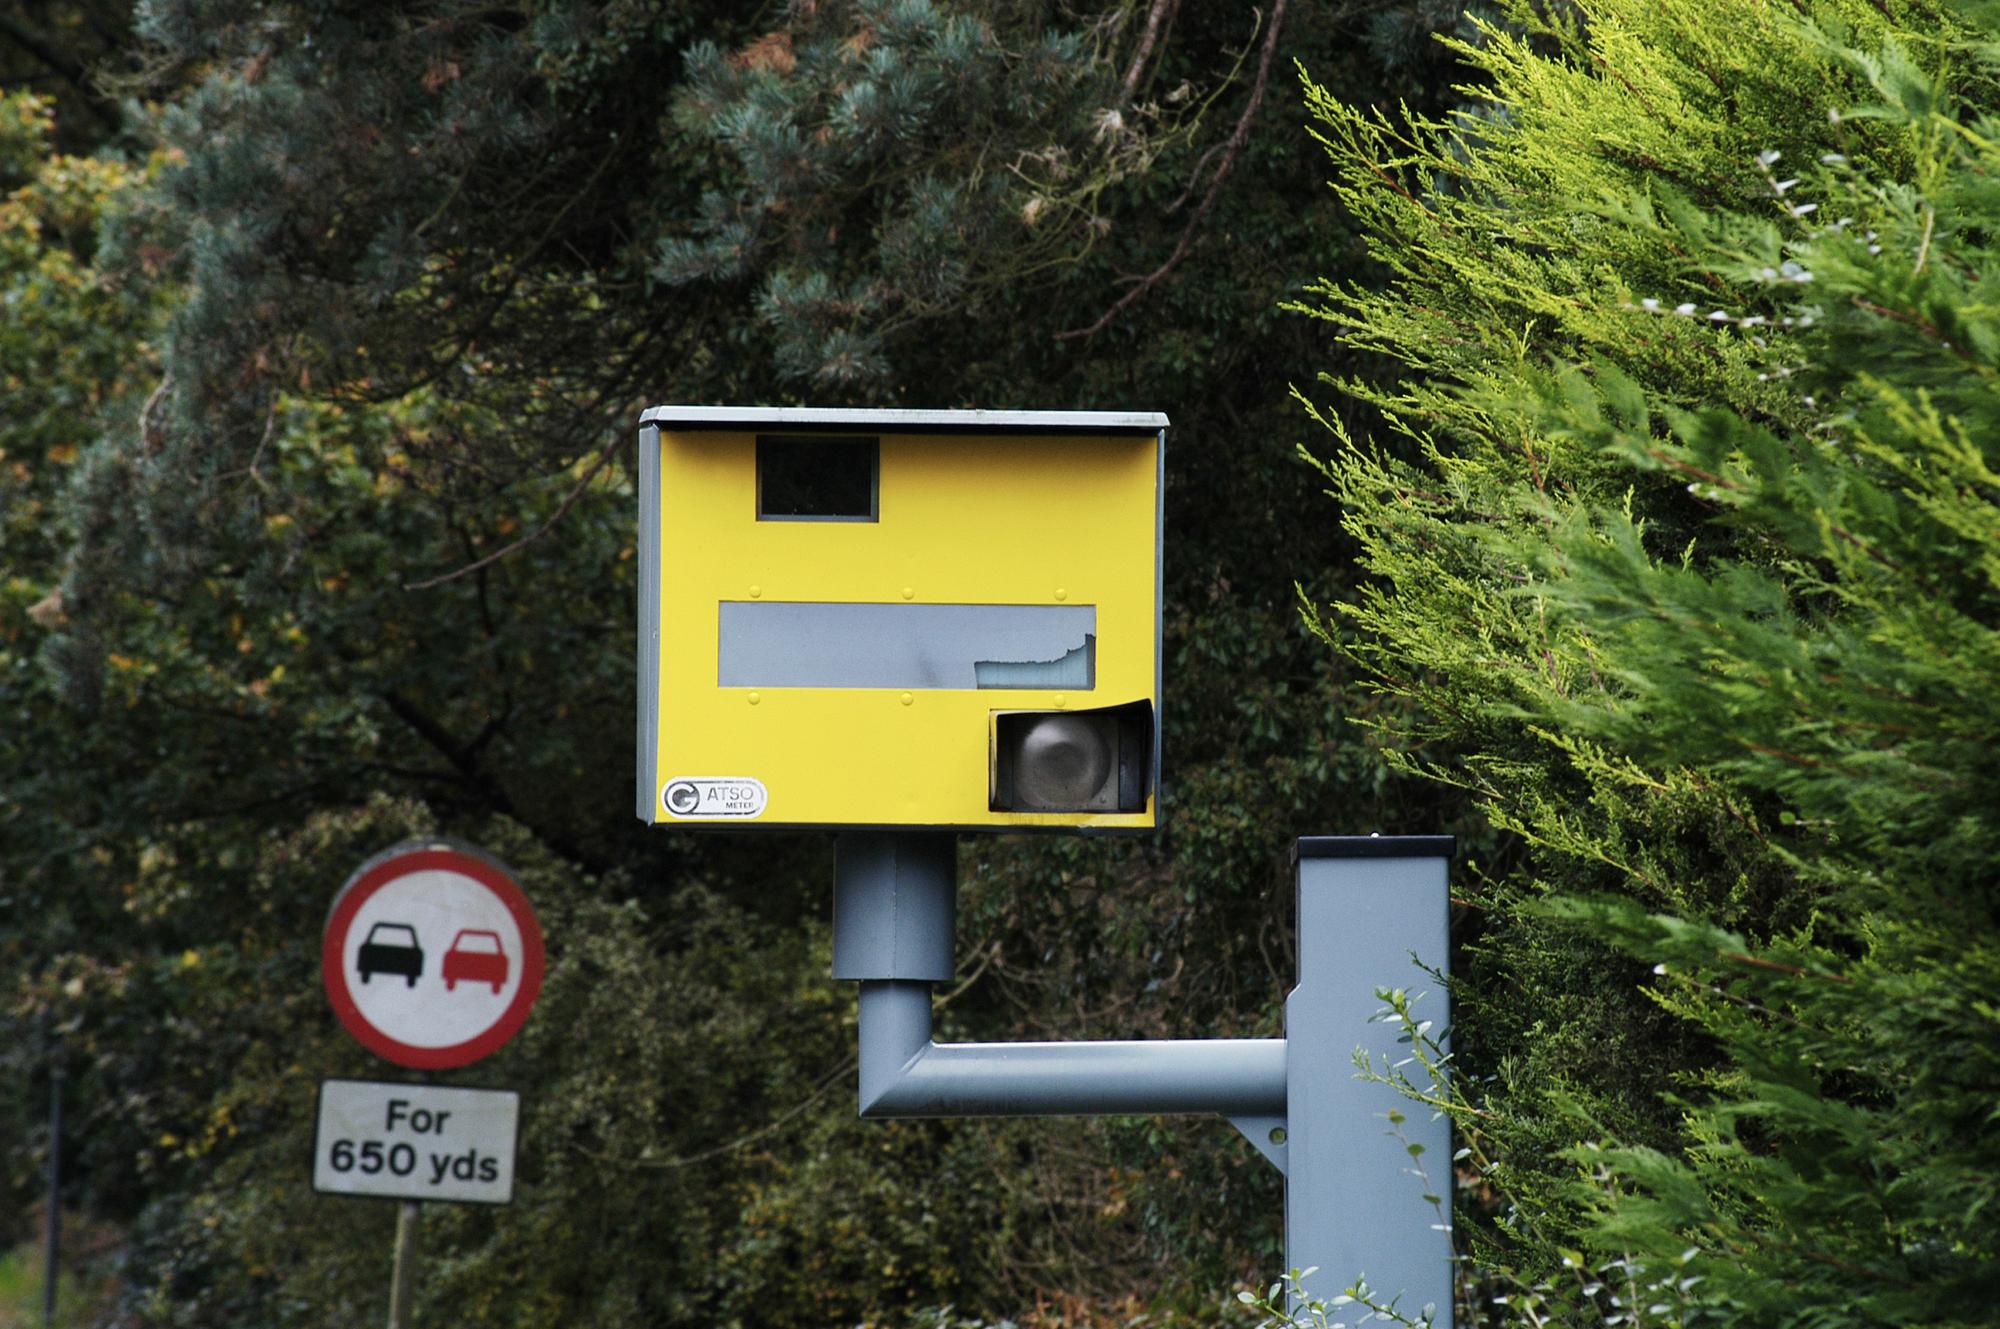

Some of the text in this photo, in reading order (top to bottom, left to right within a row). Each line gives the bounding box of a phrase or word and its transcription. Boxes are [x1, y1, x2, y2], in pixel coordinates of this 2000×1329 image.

[386, 1099, 451, 1134] For
[330, 1139, 498, 1184] 650 yds
